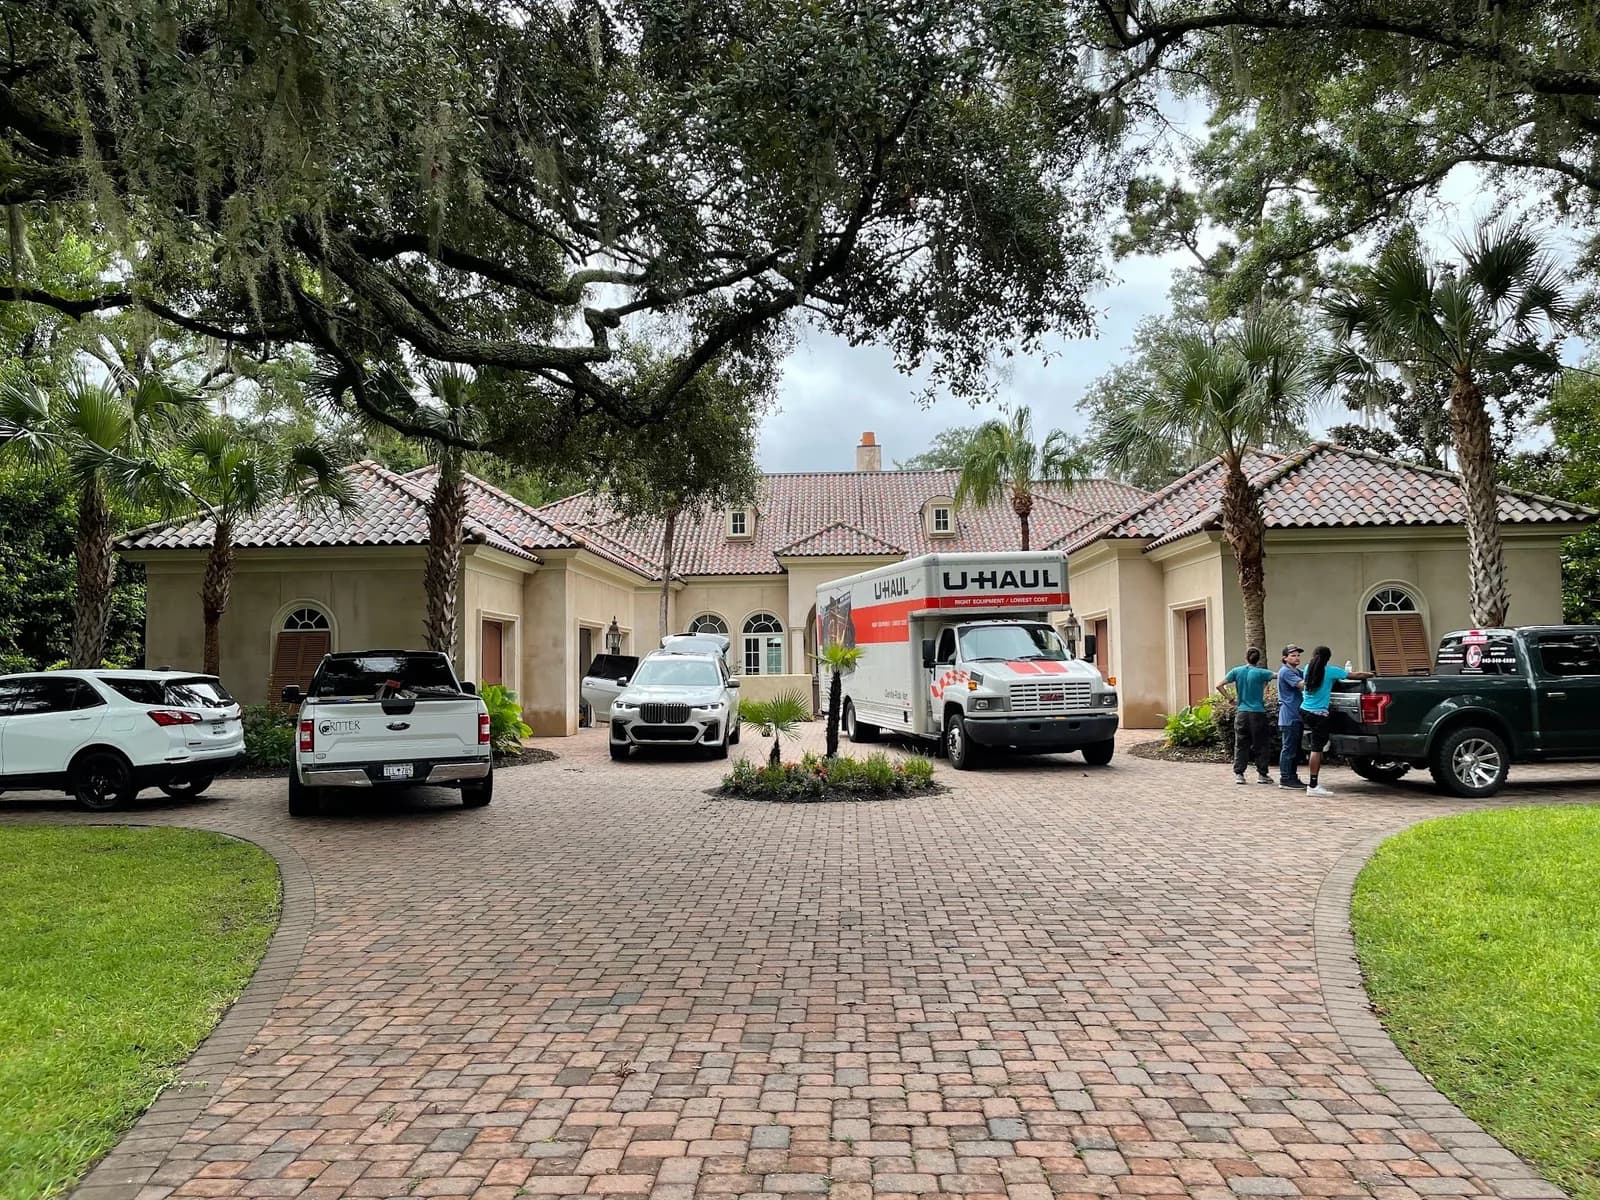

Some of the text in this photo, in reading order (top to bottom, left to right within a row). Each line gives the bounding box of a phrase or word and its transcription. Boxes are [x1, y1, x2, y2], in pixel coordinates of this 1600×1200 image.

[874, 576, 909, 600] U-HAUL
[943, 570, 1059, 590] U-HAUL
[318, 719, 361, 736] CRITTER
